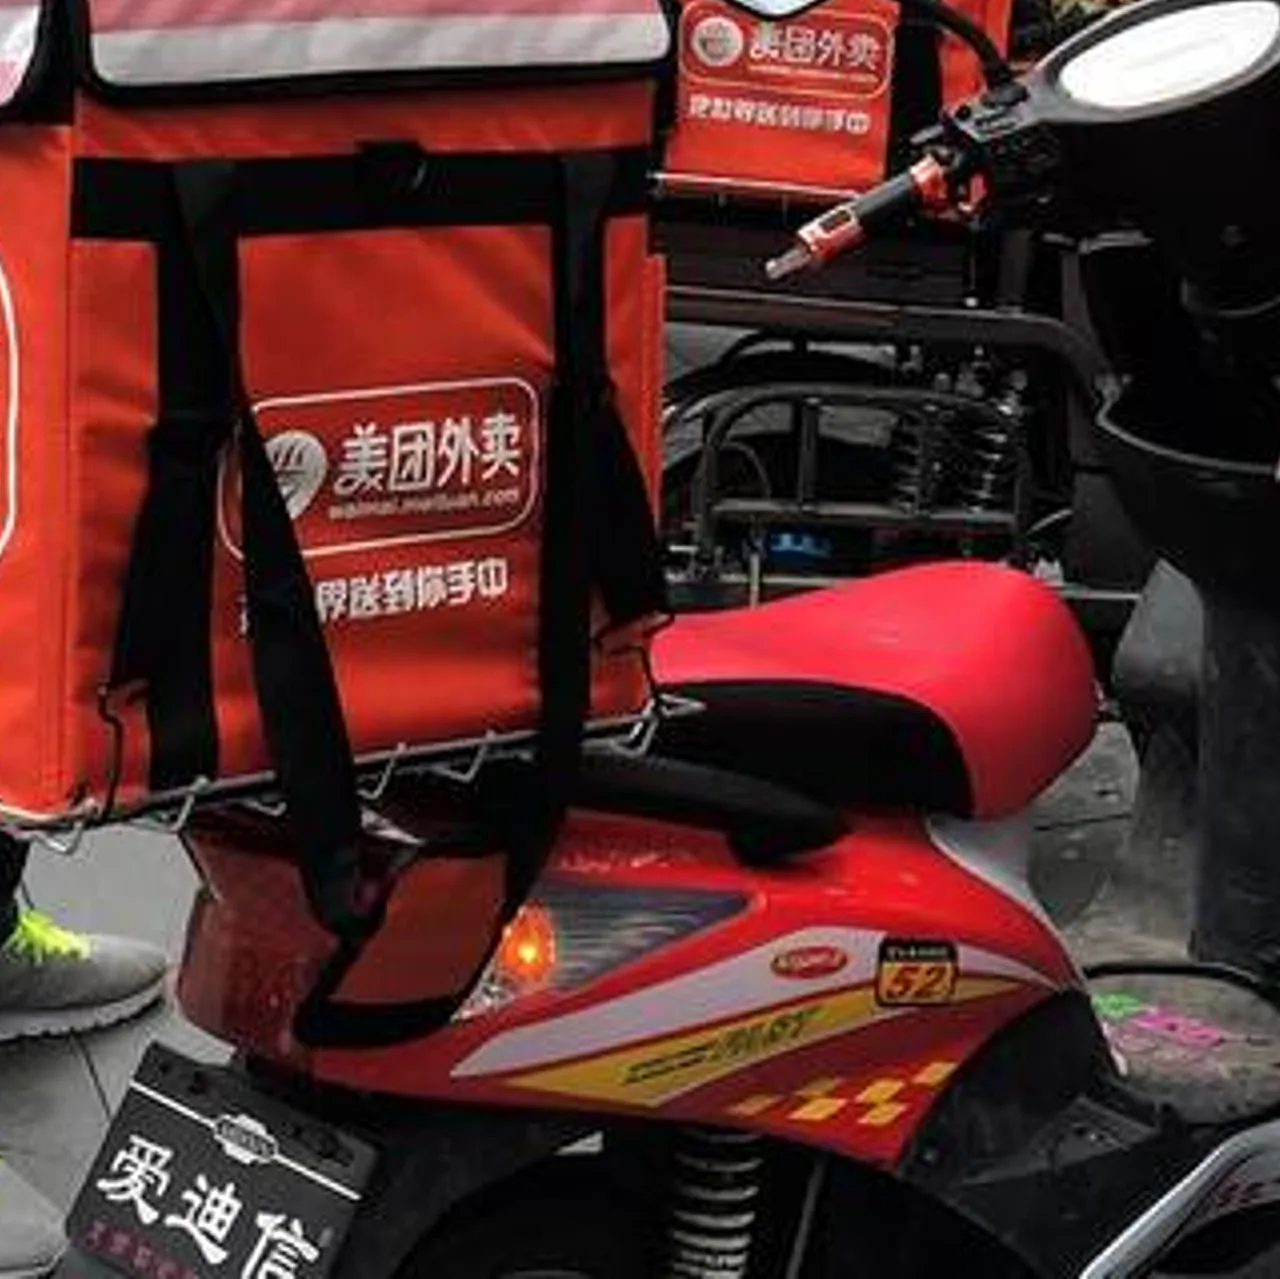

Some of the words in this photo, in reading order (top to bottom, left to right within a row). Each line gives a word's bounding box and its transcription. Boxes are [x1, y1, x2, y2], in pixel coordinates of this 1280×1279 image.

[332, 412, 522, 498] 美团外卖
[239, 557, 509, 634] 界送到你手中
[883, 965, 948, 1001] 52
[96, 1133, 320, 1279] 爱迪信
